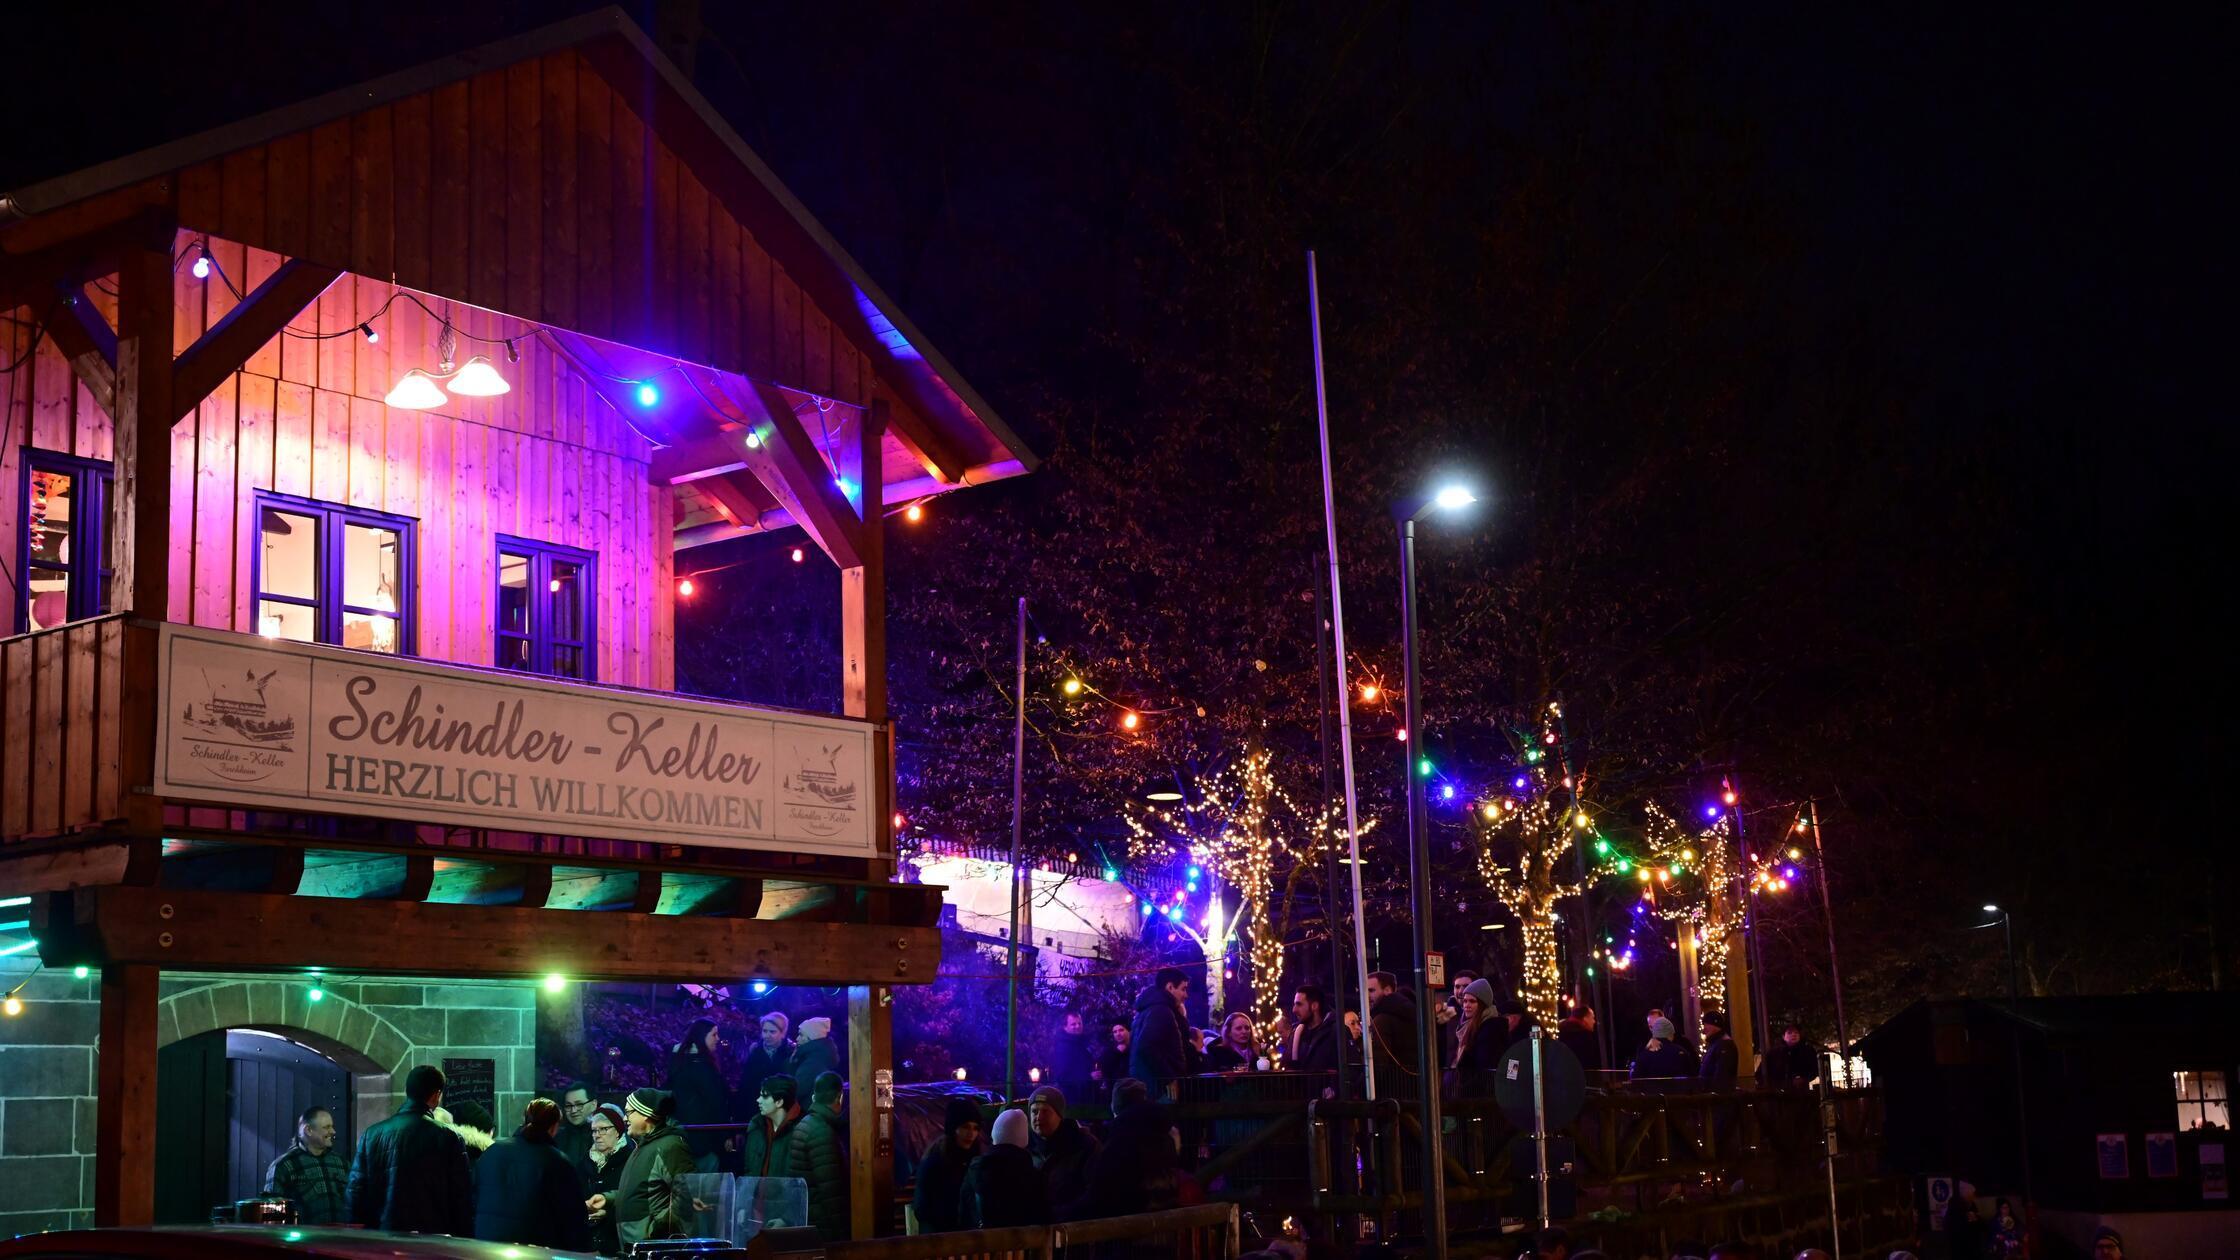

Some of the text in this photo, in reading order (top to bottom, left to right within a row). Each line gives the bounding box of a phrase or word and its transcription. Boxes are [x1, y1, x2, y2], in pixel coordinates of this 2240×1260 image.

[190, 744, 239, 762] Schindler
[250, 751, 285, 768] Keller
[328, 676, 572, 765] Schindler
[607, 711, 761, 785] Keller
[325, 753, 764, 830] HERZLICH WILLKOMMEN
